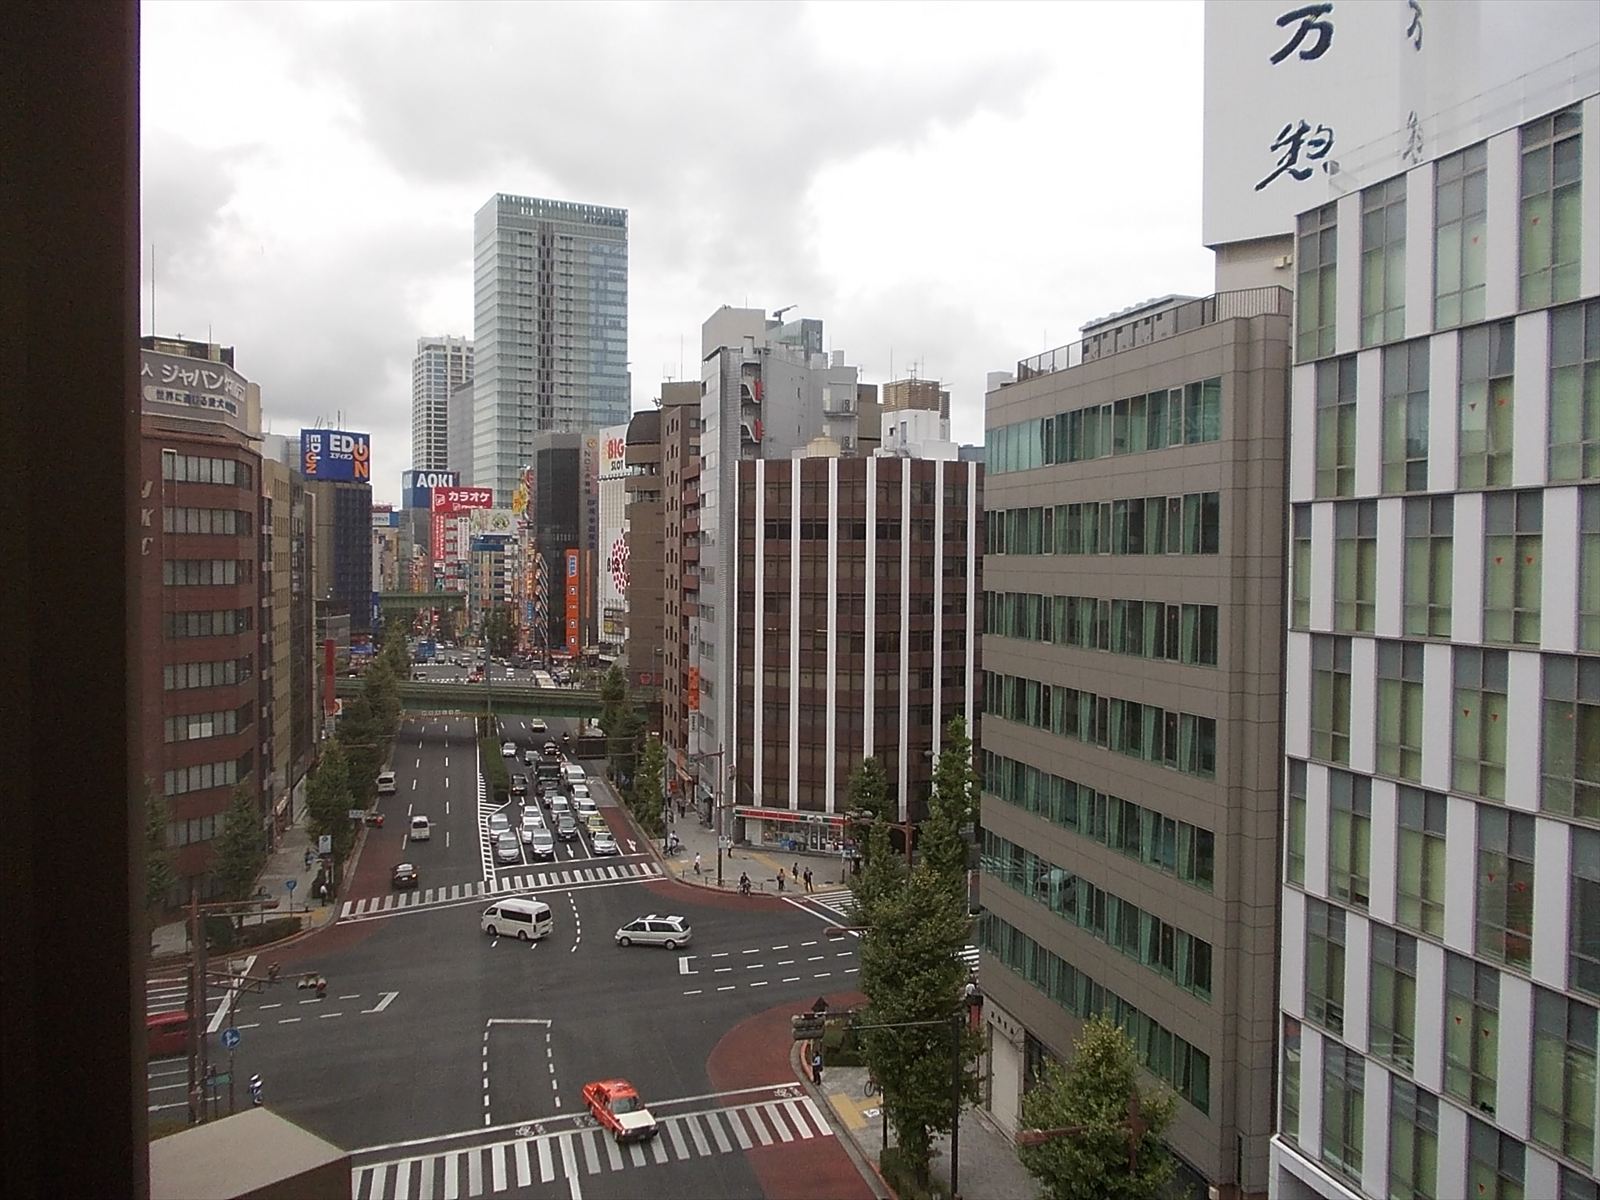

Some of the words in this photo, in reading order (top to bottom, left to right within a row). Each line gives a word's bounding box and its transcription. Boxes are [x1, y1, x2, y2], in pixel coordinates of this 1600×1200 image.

[607, 438, 625, 460] BIG
[416, 473, 454, 488] AOKI
[448, 491, 490, 502] カラオケ
